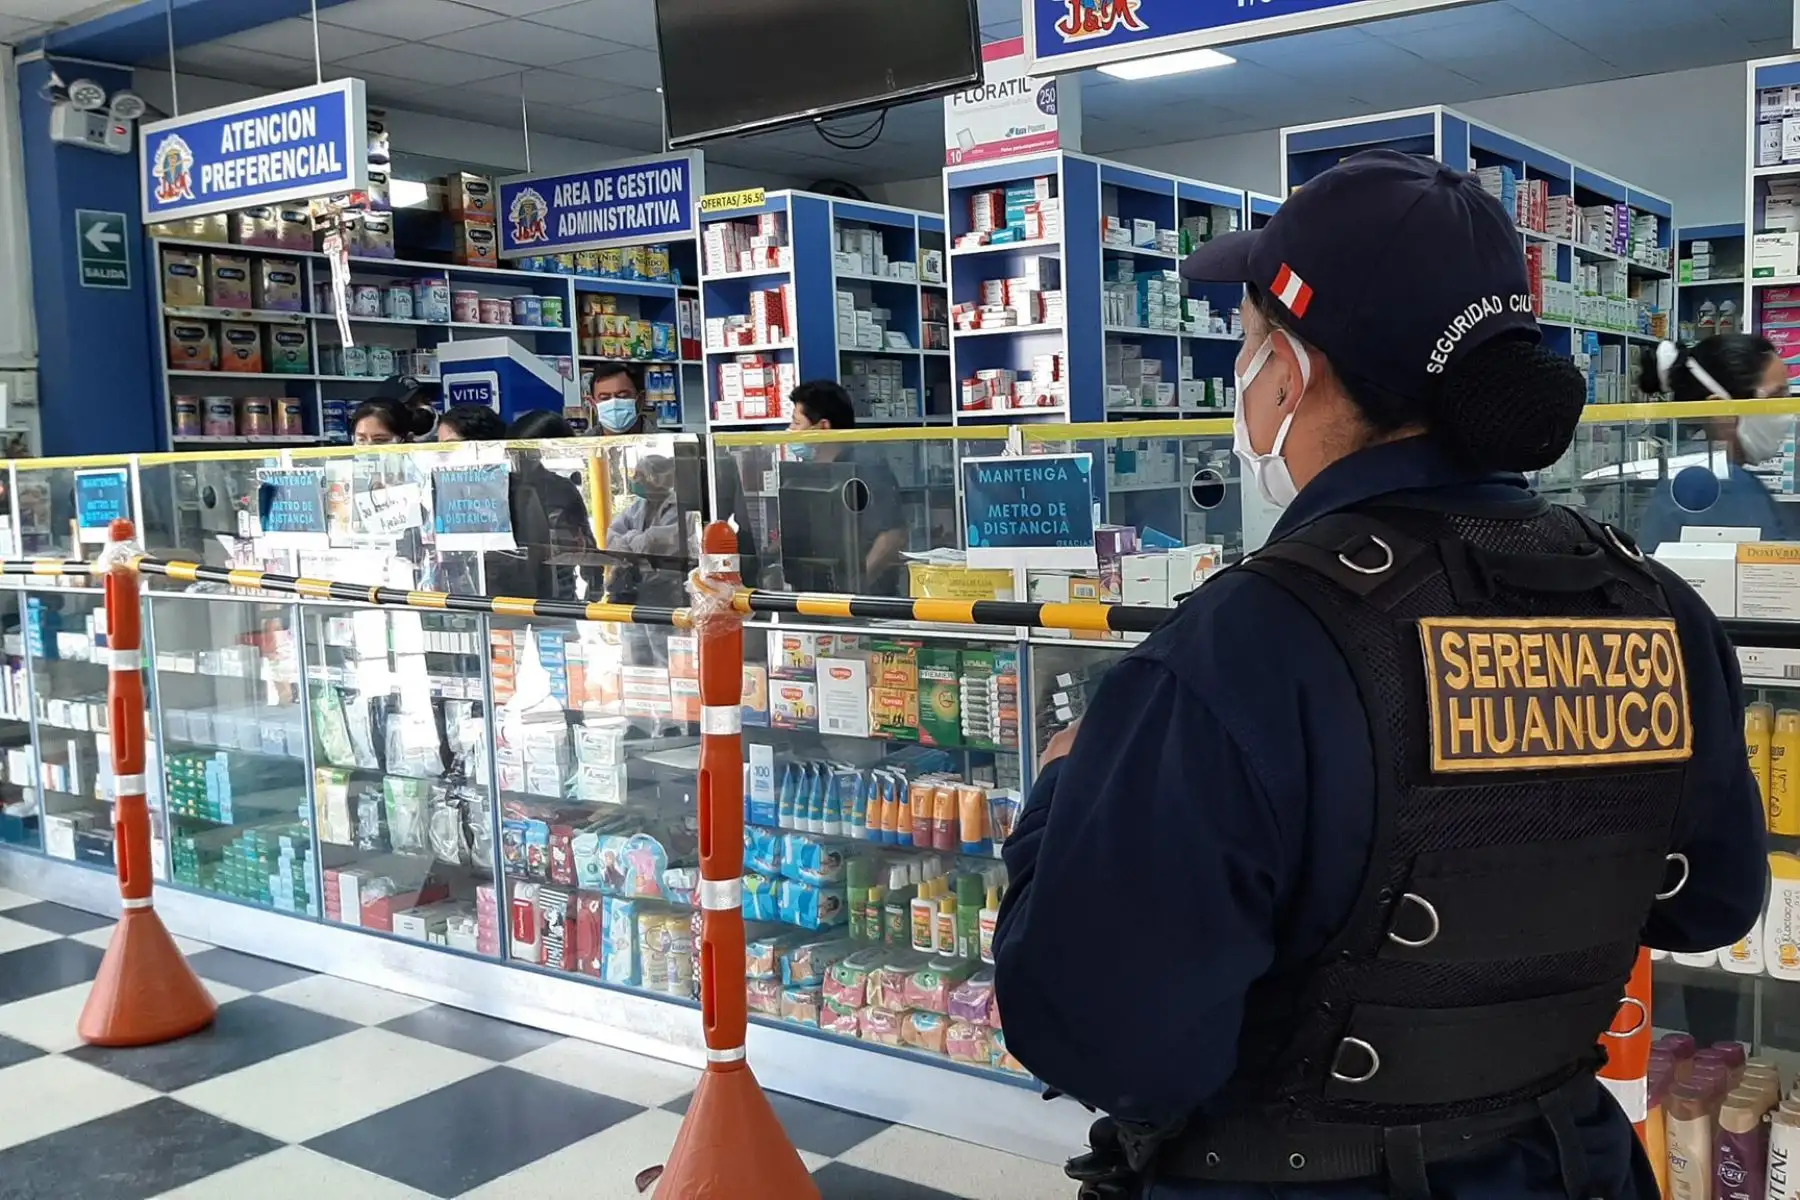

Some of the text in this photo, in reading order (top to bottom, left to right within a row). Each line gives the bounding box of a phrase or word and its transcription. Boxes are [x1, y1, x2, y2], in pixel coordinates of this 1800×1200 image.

[953, 77, 1031, 106] FLORATIL
[1039, 87, 1056, 105] 250
[221, 106, 316, 153] ATENCION
[950, 151, 962, 163] 10
[201, 142, 341, 194] PREFERENCIAL
[553, 166, 682, 208] AREA DE GESTION
[558, 199, 680, 237] ADMINISTRATIVA
[85, 267, 126, 280] SALIDA
[1427, 295, 1503, 374] SEGURIDAD
[453, 387, 489, 401] VITIS
[978, 467, 1067, 483] MANTENGA
[1020, 486, 1026, 499] 1
[272, 501, 302, 511] METRO
[448, 500, 497, 510] METRO DE
[988, 502, 1067, 517] METRO DE
[269, 513, 313, 524] DISTANCIA
[446, 513, 498, 524] DISTANCIA
[983, 521, 1070, 535] DISTANCIA
[1440, 631, 1675, 690] SERENAZGO
[1449, 691, 1679, 754] HUANUCO
